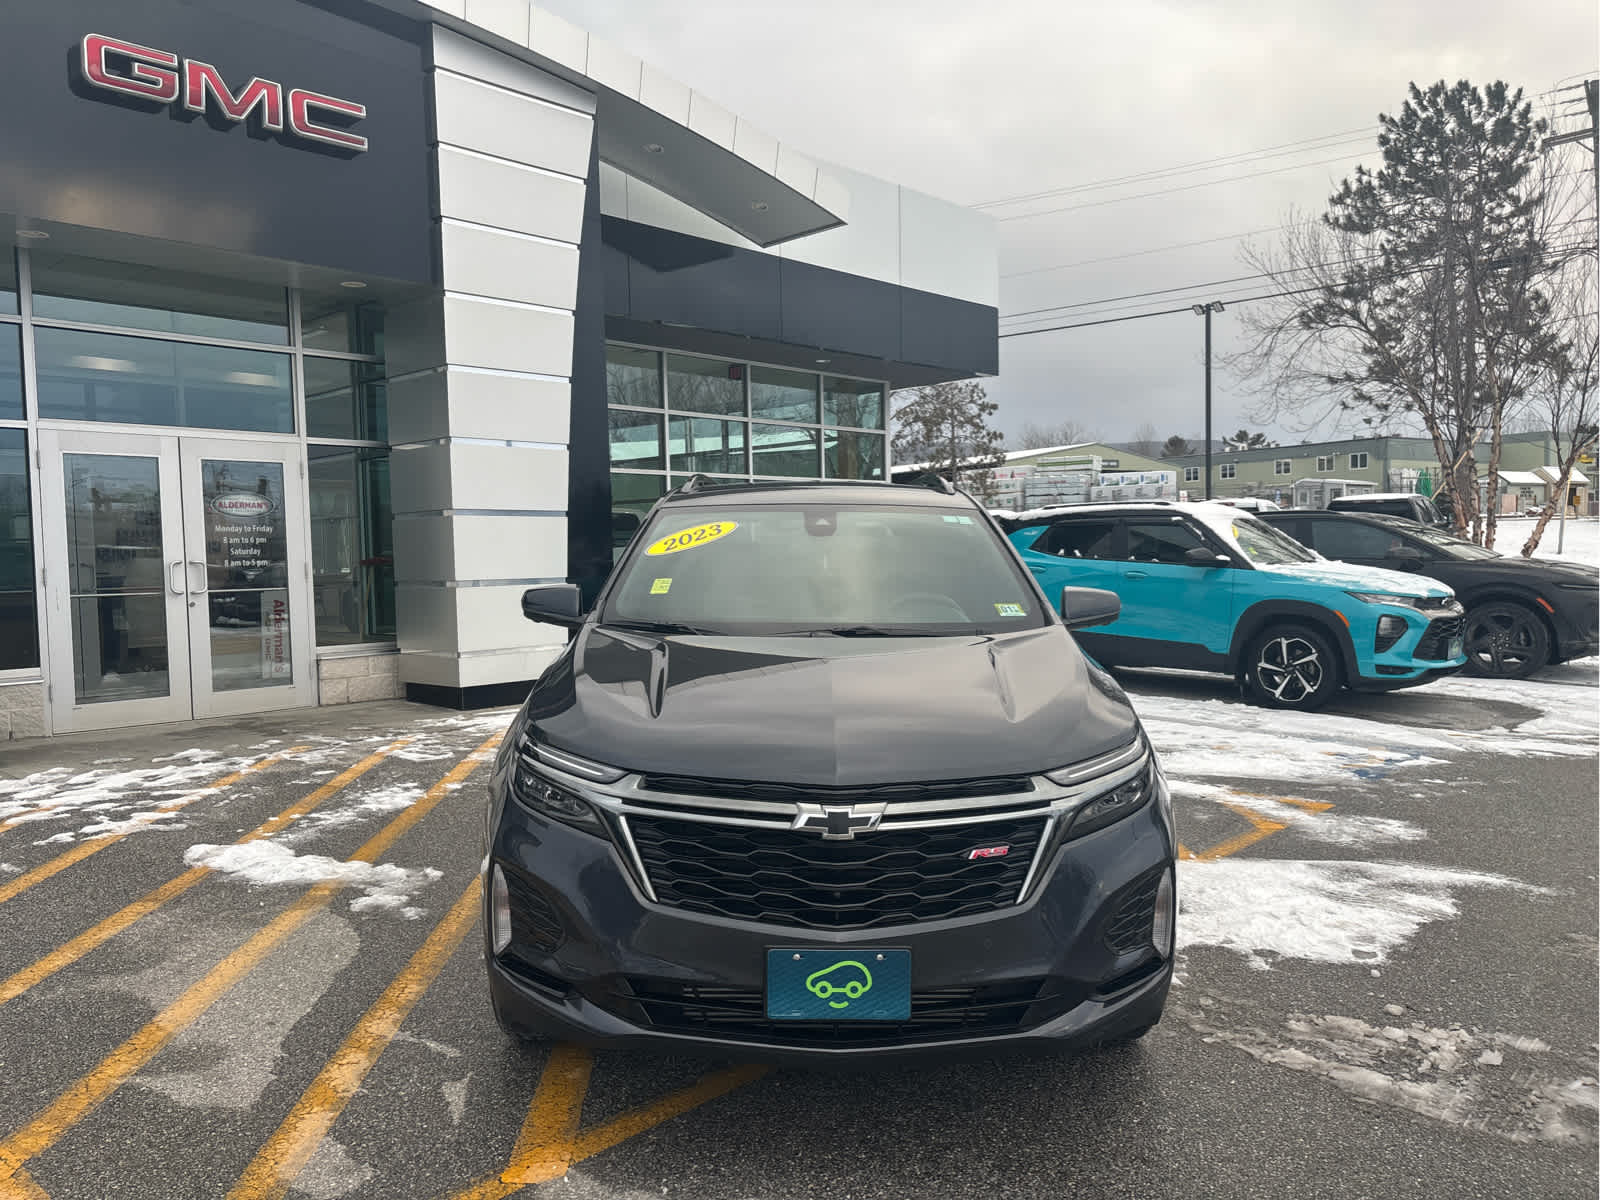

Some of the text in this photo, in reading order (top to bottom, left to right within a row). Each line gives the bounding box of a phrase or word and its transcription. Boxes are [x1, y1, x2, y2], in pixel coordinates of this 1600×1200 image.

[82, 33, 368, 152] GMC
[215, 525, 273, 534] Monday to Friday
[255, 537, 267, 545] pm
[663, 524, 722, 551] 2023
[230, 547, 261, 557] Saturday
[256, 560, 268, 568] pm
[968, 846, 1009, 859] RS
